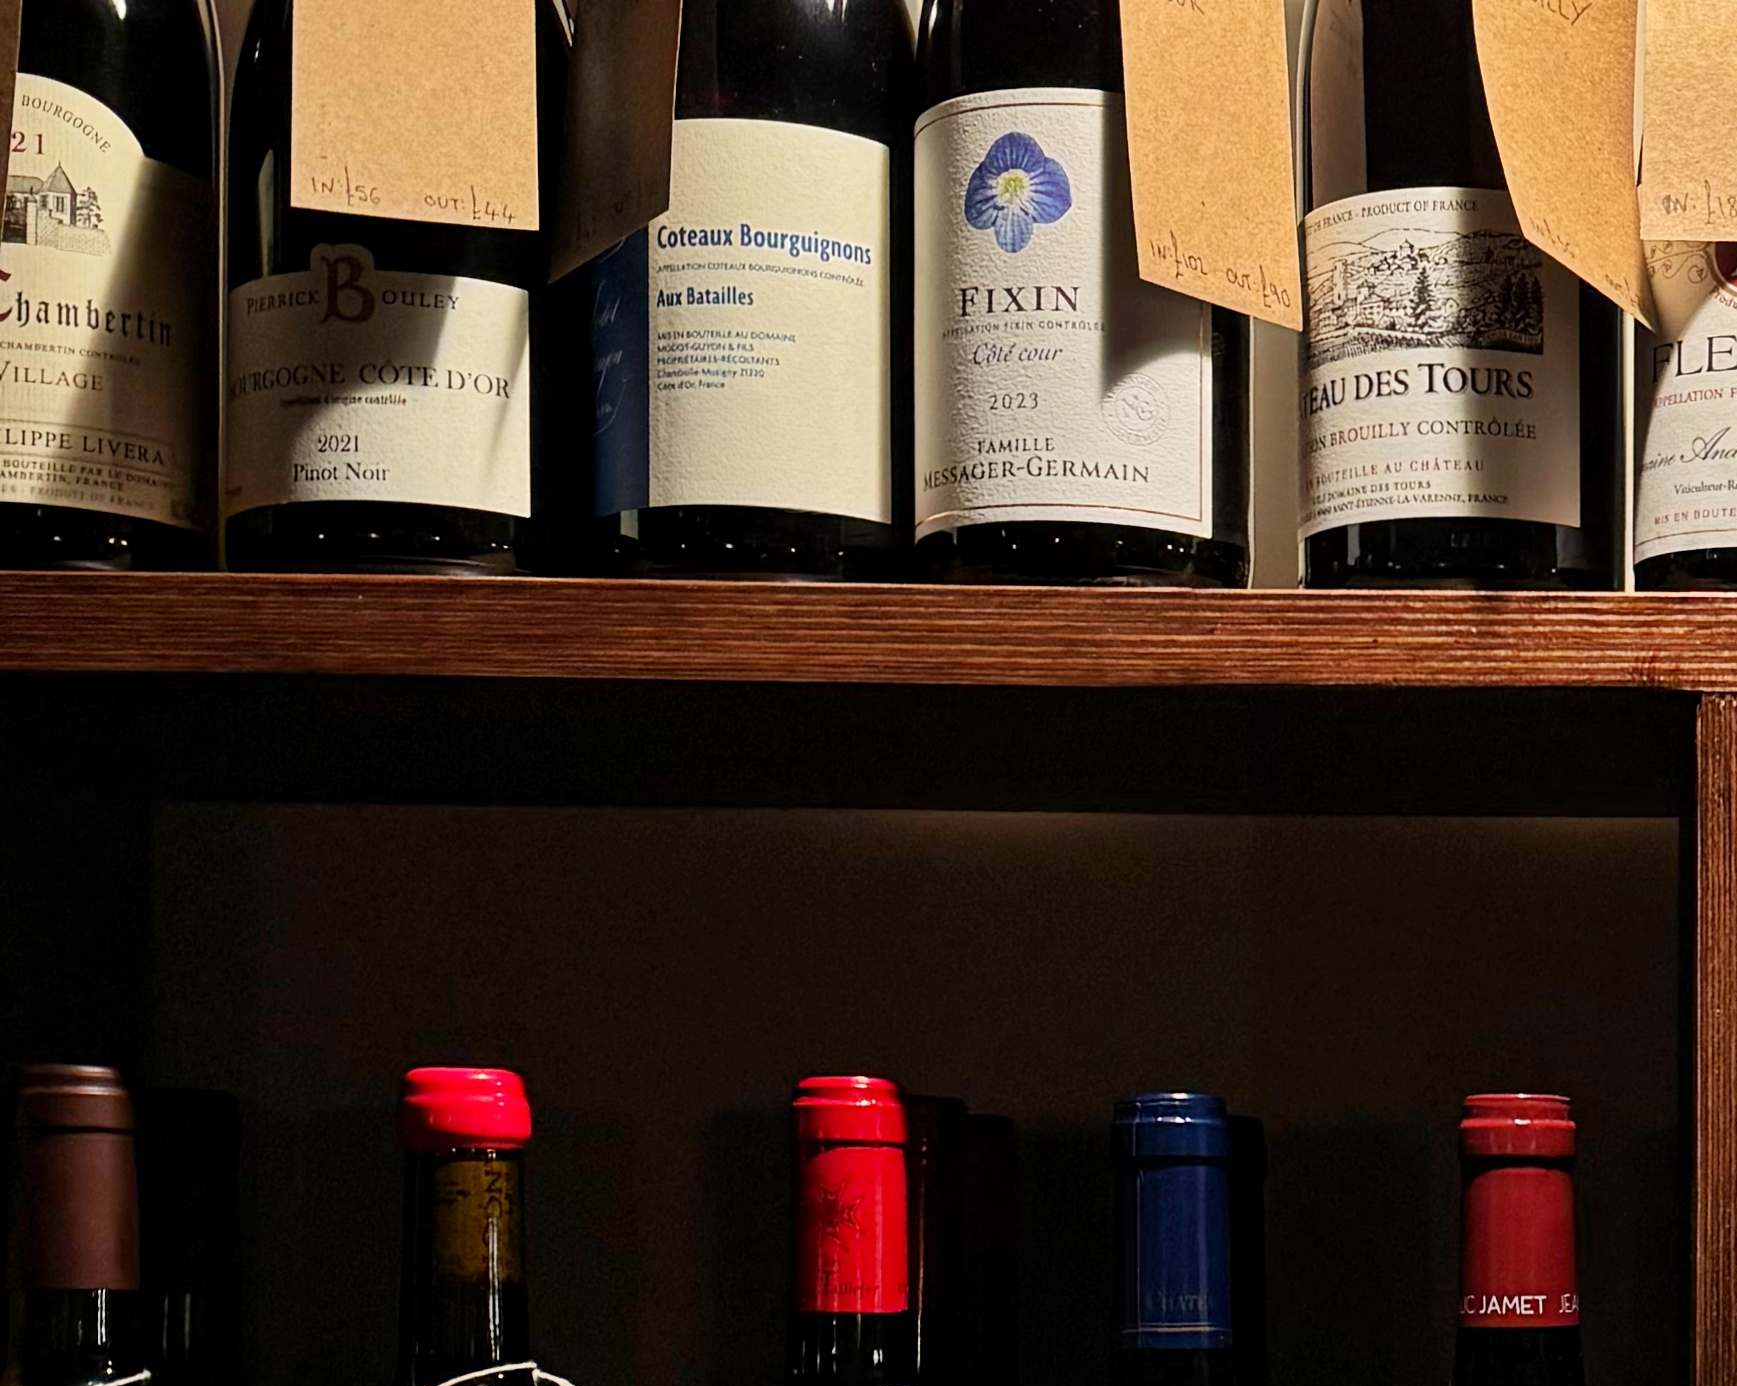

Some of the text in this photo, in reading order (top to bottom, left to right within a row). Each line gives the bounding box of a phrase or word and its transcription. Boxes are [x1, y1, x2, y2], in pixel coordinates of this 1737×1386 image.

[21, 94, 112, 154] BOURGOGNE
[1361, 198, 1480, 218] PRODUCT FRANCE
[657, 223, 872, 265] Coteaux Bourguignons
[246, 290, 320, 314] PIERRICK
[657, 286, 754, 307] Aux Batailles
[960, 284, 1081, 317] FIXIN
[972, 341, 1063, 367] Côté cour
[358, 356, 441, 393] CÔTE
[1354, 362, 1534, 401] DES TOURS
[988, 392, 1040, 411] 2023
[316, 432, 361, 454] 2021
[976, 437, 1056, 456] FAMILLE
[1329, 416, 1537, 453] BROUILLY CONTRÔLÉE
[83, 435, 164, 466] LIVERA
[293, 461, 390, 483] Pinot Noir
[923, 456, 1150, 493] MESSAGER-GERMAIN
[1410, 455, 1485, 473] CHÂTEAU
[1480, 1295, 1547, 1315] JAMET
